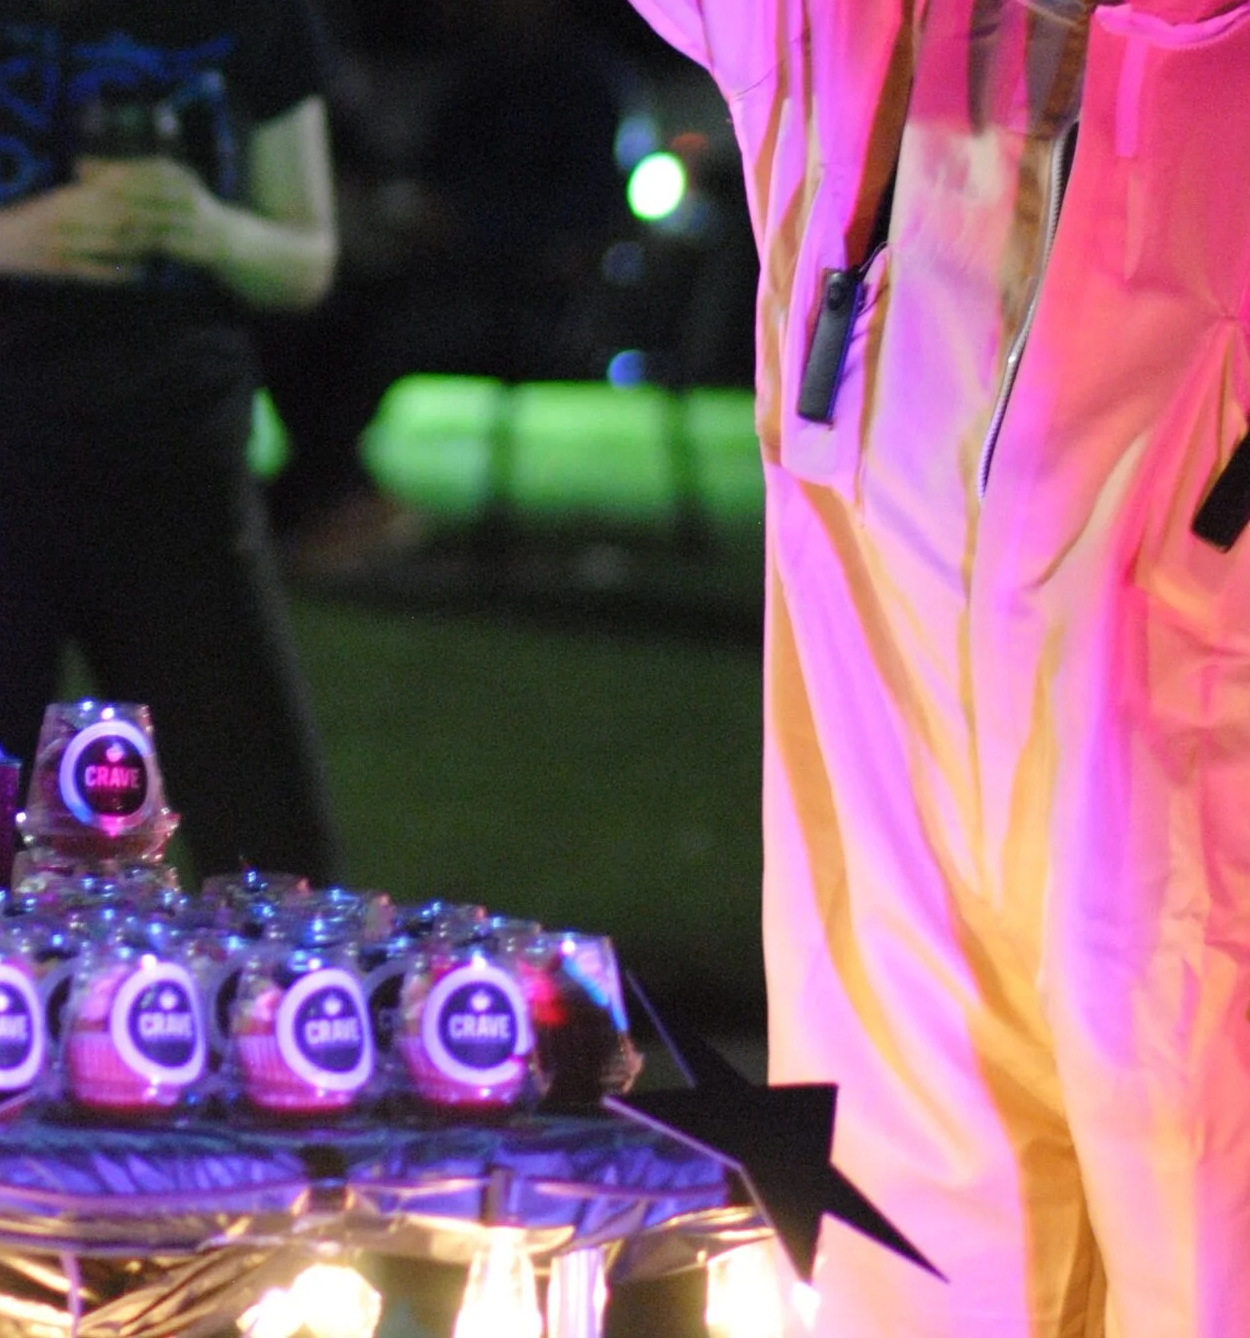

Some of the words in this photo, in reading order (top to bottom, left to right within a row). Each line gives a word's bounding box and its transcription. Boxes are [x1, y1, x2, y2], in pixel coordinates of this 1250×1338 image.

[85, 764, 141, 789] CRAVE
[304, 1015, 361, 1045] CRAVE
[450, 1013, 511, 1041] CRAVE
